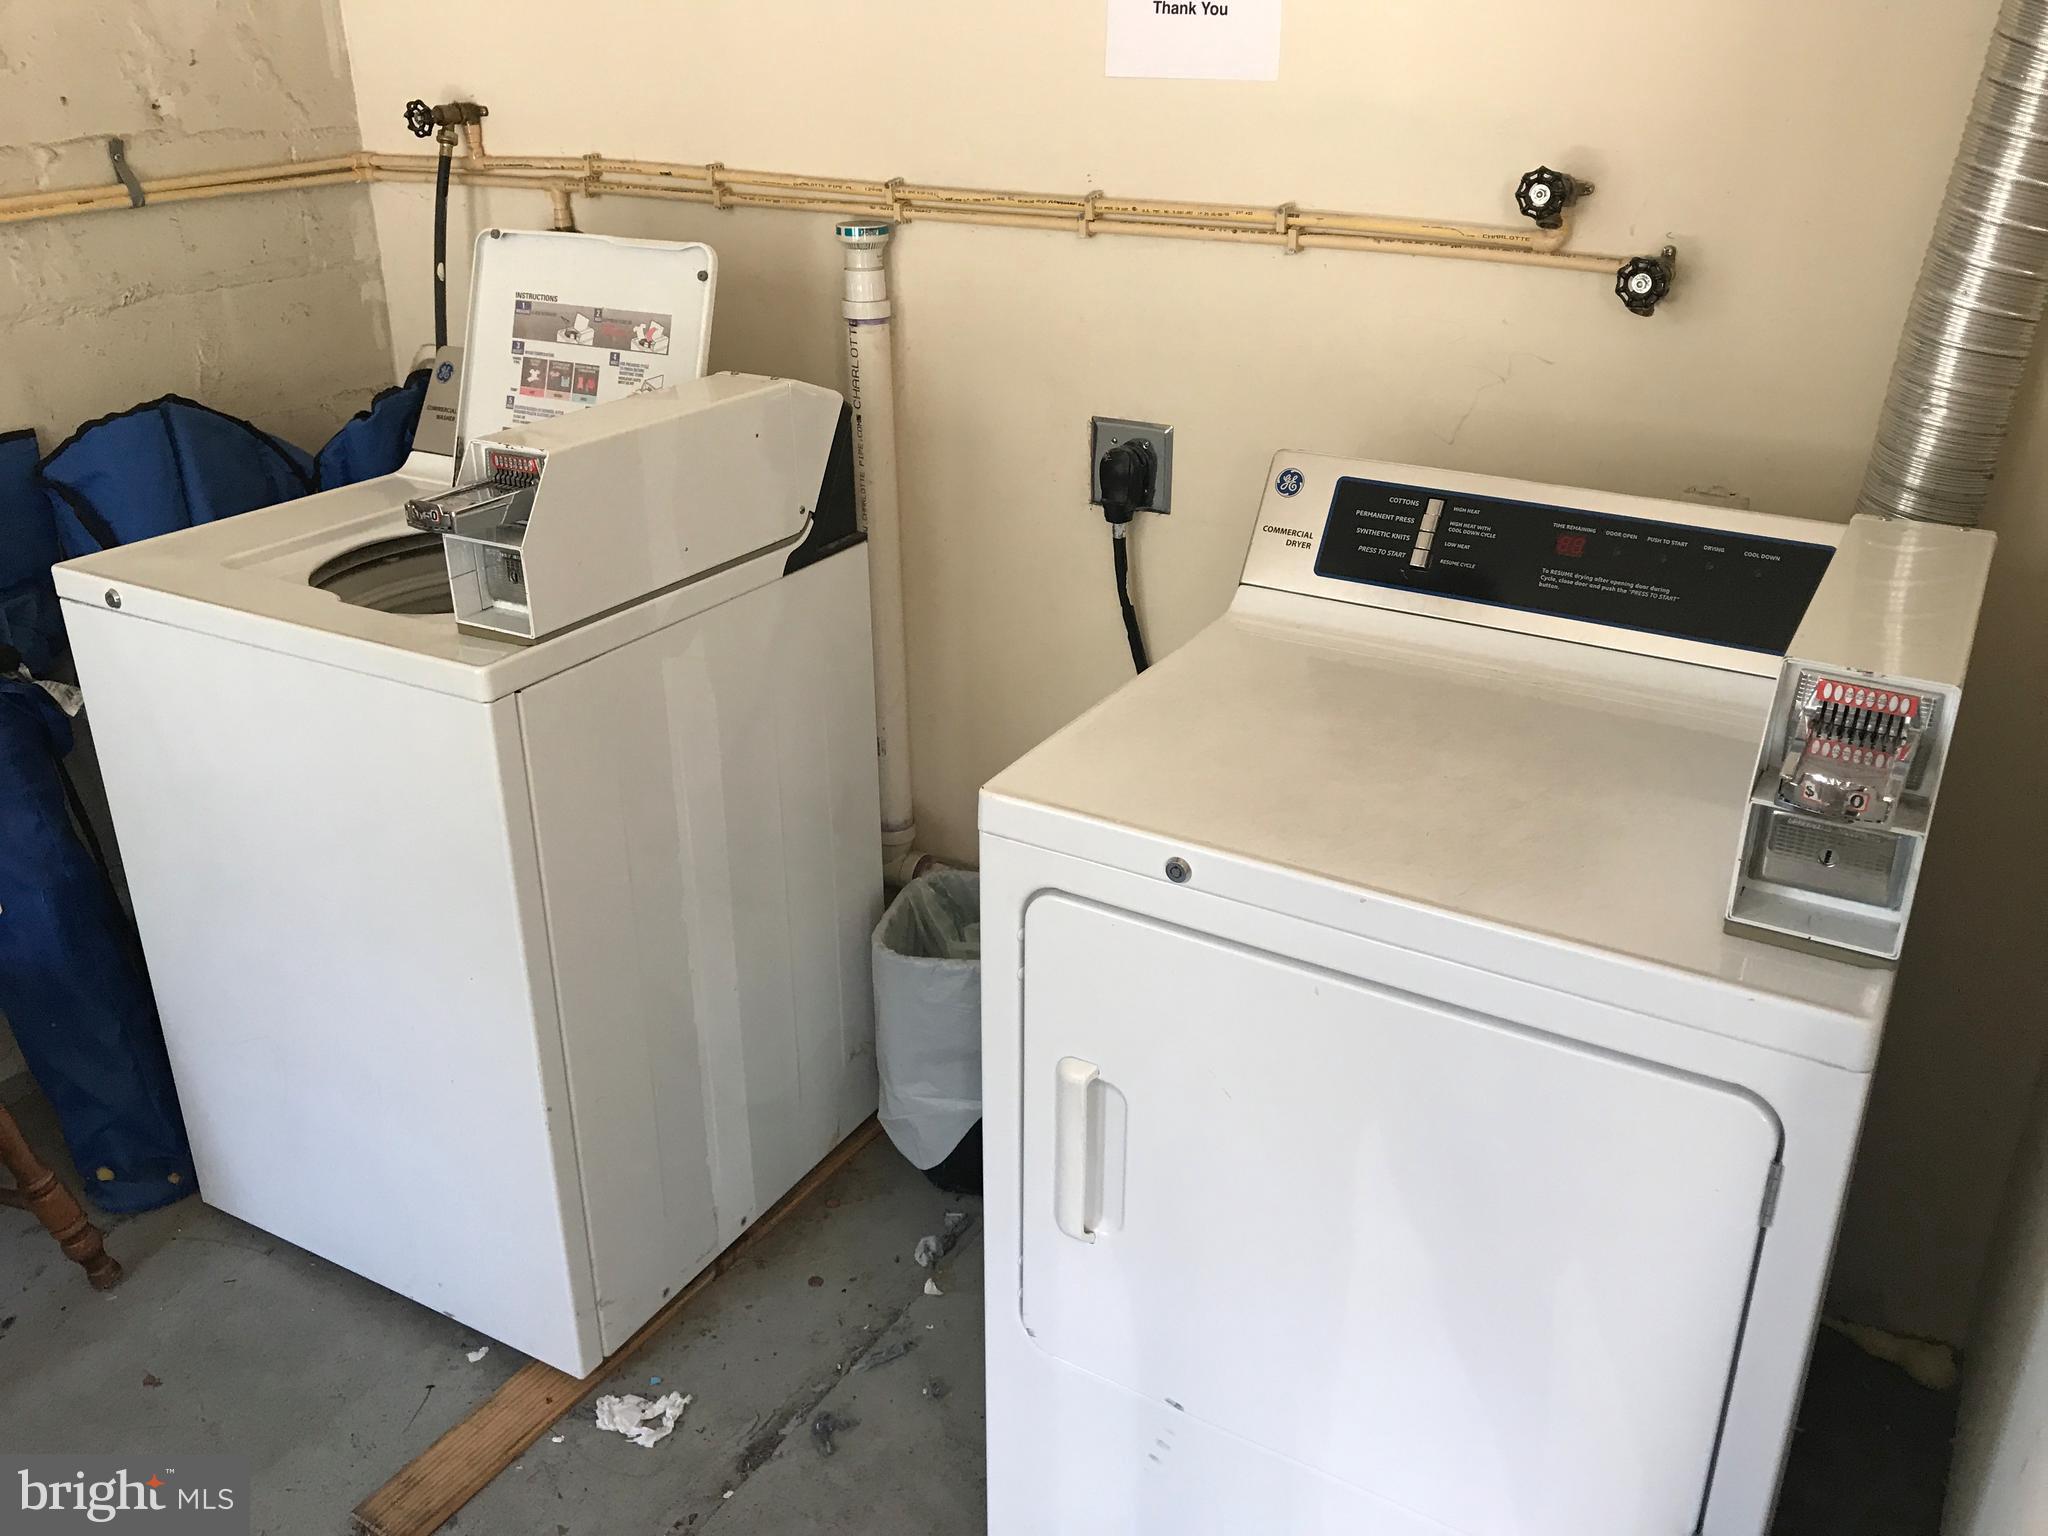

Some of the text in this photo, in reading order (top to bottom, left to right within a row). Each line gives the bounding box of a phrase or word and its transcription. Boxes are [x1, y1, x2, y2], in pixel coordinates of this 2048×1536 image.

[1153, 1, 1228, 16] Thank You
[1482, 233, 1530, 242] CHARLOTTE
[515, 291, 558, 303] INSTRUCTIONS
[849, 319, 861, 409] CHARLOTTE
[1389, 496, 1420, 507] COTTONS
[1355, 509, 1415, 524] PERMANENT PRESS
[1263, 525, 1314, 539] COMMERCIAL
[1356, 527, 1411, 541] SYNTHETIC KNITS
[1566, 524, 1597, 534] REMAINING
[1605, 530, 1638, 540] DOOR OPEN
[1286, 539, 1312, 550] DRYER
[1647, 536, 1662, 544] PUSH
[1671, 540, 1688, 548] START
[1357, 545, 1377, 554] PRESS
[1387, 550, 1406, 558] START
[1703, 545, 1725, 553] DRYING
[1743, 551, 1781, 562] COOL DOWN
[1440, 559, 1460, 567] RESUME
[1538, 582, 1560, 590] button.
[1550, 569, 1573, 578] RESUME
[1574, 572, 1593, 582] drying
[1594, 576, 1609, 584] after
[1610, 578, 1634, 589] opening
[1649, 585, 1670, 594] during
[1558, 578, 1574, 586] close
[1589, 582, 1600, 590] and
[1601, 584, 1616, 593] push
[1617, 586, 1627, 594] the
